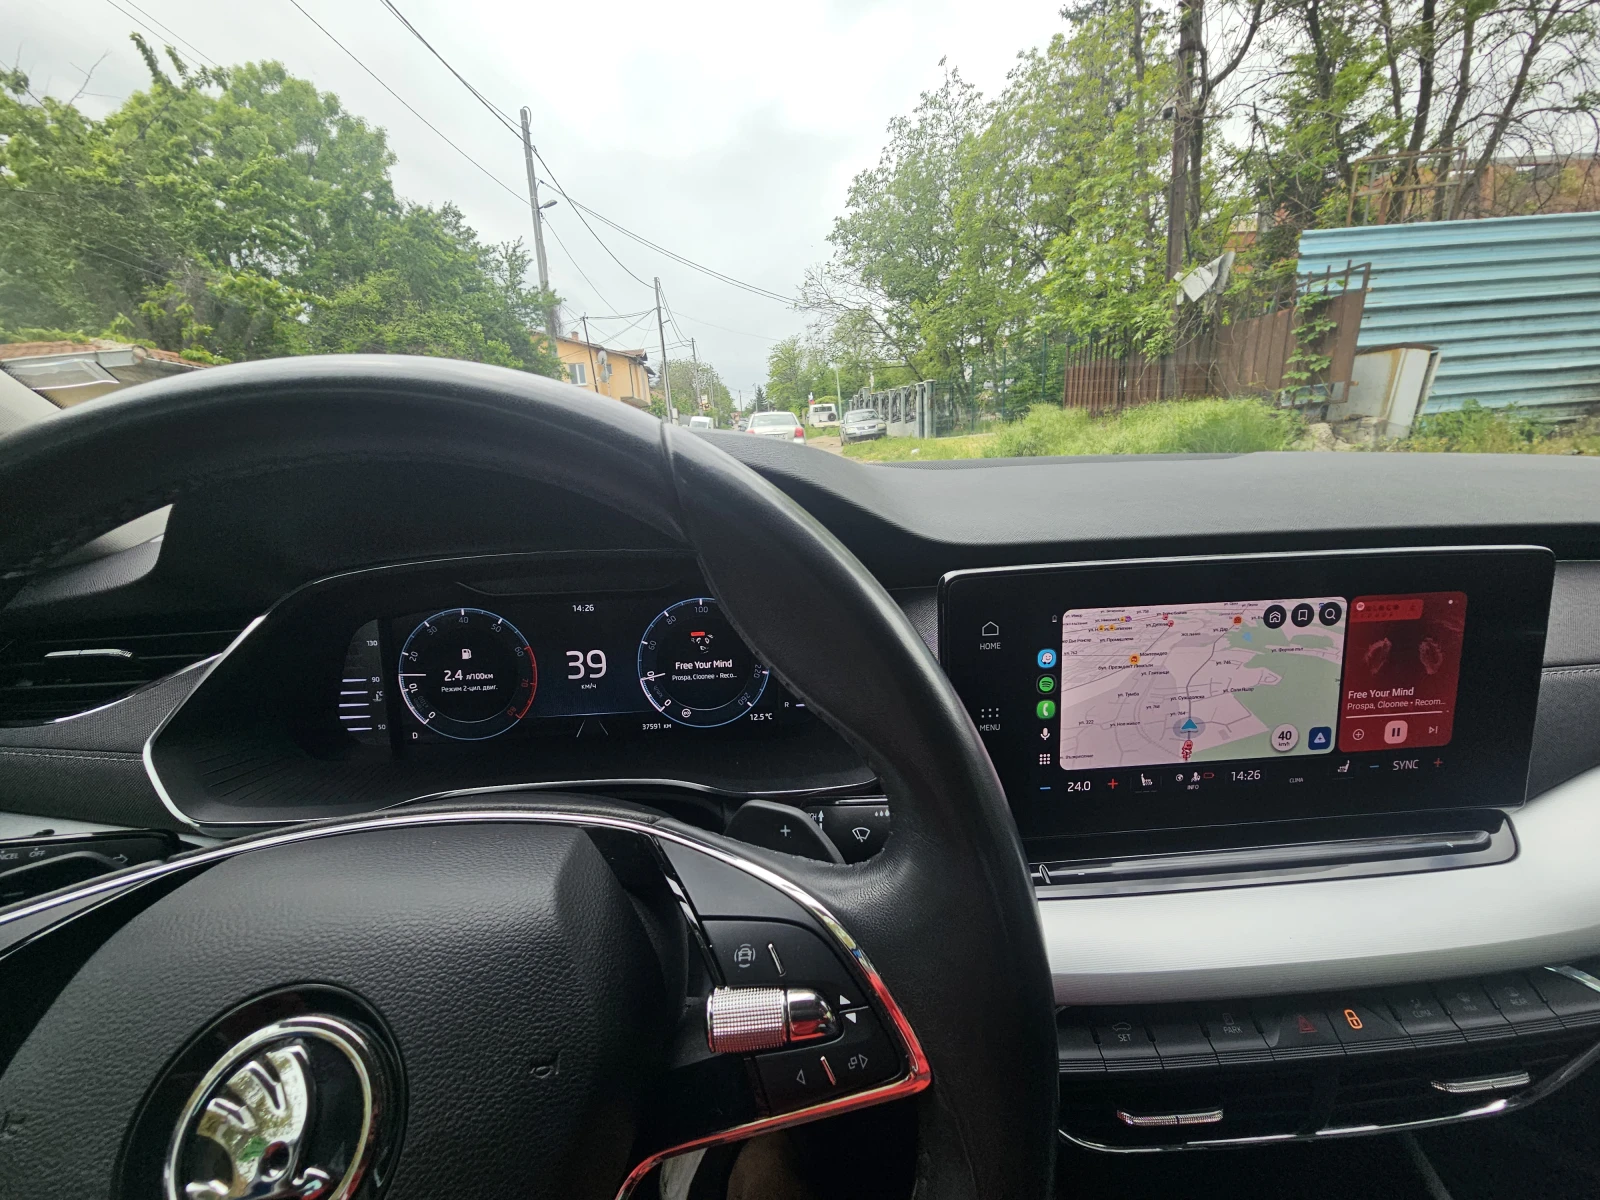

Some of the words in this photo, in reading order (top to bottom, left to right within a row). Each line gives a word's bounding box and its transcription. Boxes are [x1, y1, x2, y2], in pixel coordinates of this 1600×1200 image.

[572, 604, 595, 612] 14:26
[458, 616, 469, 624] 40
[666, 615, 677, 625] 80
[427, 626, 438, 636] 30
[491, 623, 502, 633] 50
[979, 642, 1001, 650] HOME
[409, 651, 419, 662] 20
[565, 649, 607, 680] 39
[675, 661, 693, 670] Free
[694, 660, 712, 669] Your
[713, 659, 733, 668] Mind
[443, 669, 464, 682] 2.4
[409, 683, 418, 693] 10
[1348, 690, 1368, 700] Free
[1369, 688, 1390, 698] Your
[1392, 687, 1414, 696] Mind
[664, 698, 672, 707] 0
[1347, 701, 1376, 710] Prospa,
[1377, 700, 1408, 708] Cloonee
[428, 711, 436, 720] 0
[642, 722, 661, 730] 37591
[1277, 730, 1292, 741] 40
[1392, 760, 1420, 771] SYNC
[1231, 770, 1261, 782] 14:26
[1067, 780, 1091, 792] 24.0
[28, 850, 46, 858] OFF
[1223, 1026, 1243, 1034] PARK
[1117, 1033, 1132, 1042] SET
